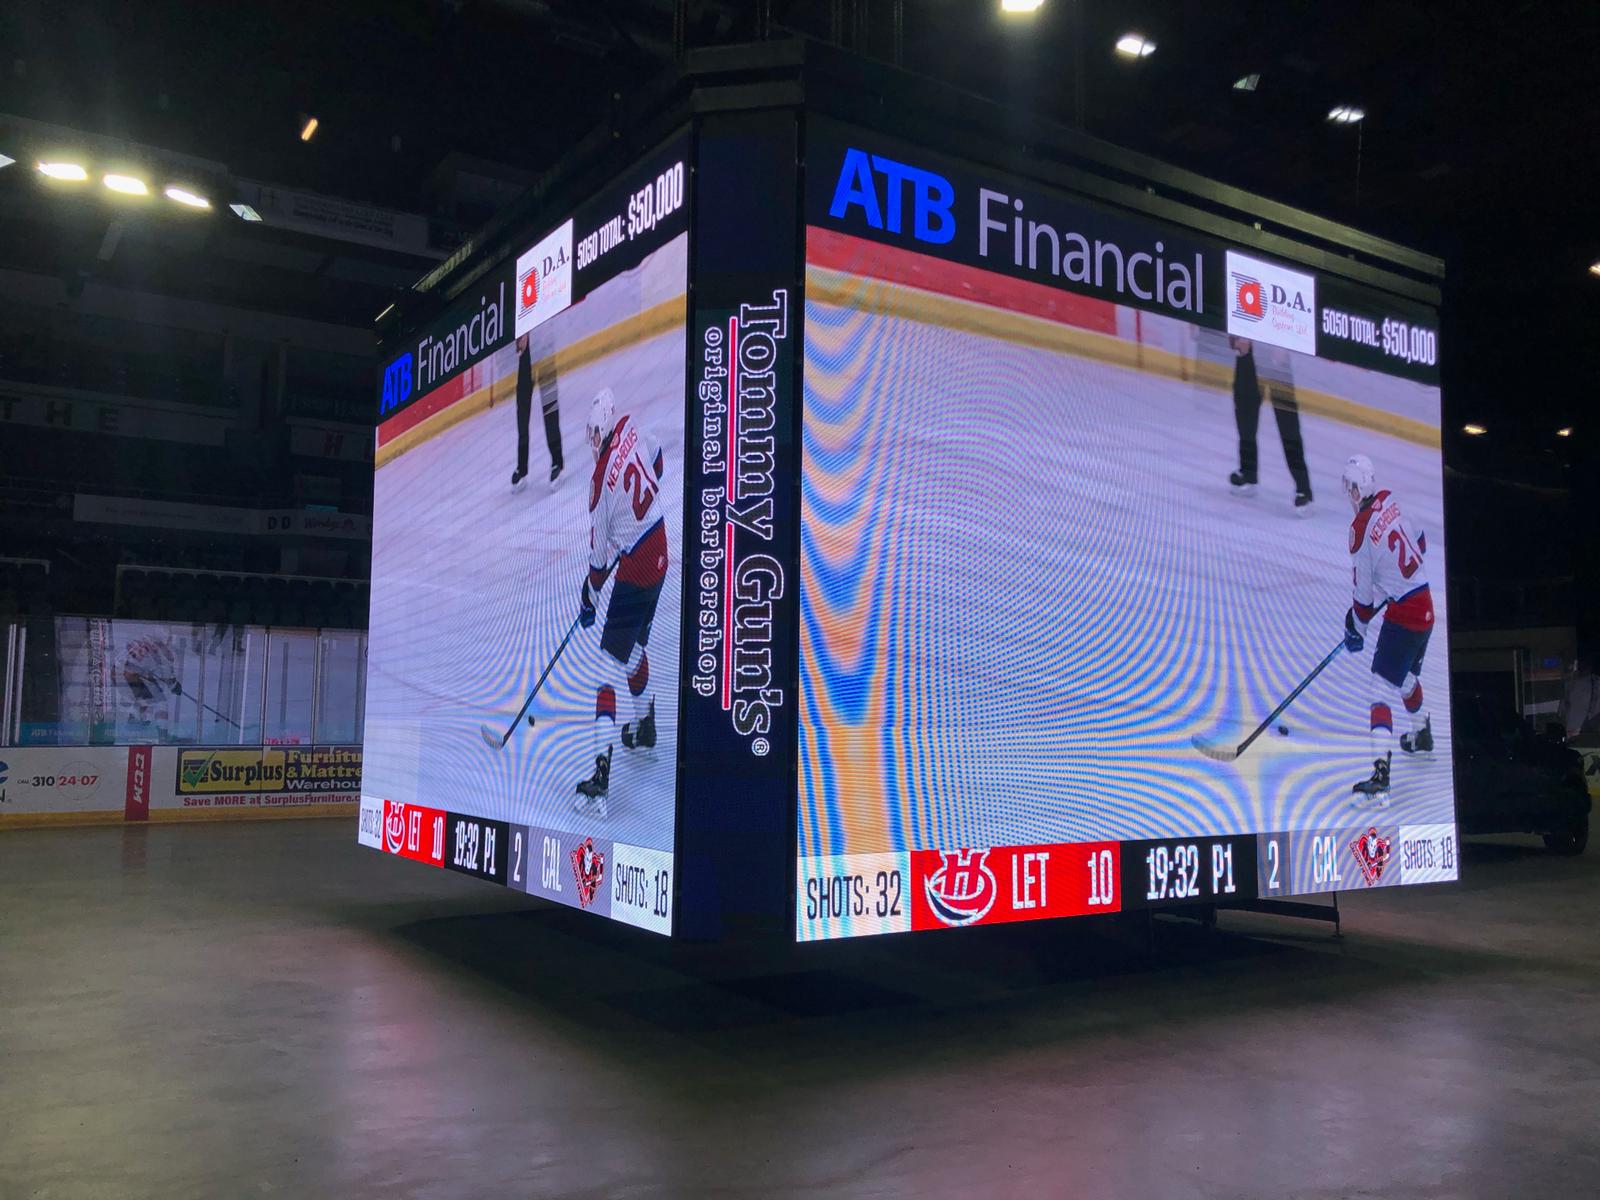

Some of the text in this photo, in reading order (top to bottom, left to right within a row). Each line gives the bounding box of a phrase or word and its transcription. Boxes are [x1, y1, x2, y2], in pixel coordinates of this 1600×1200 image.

[577, 161, 684, 270] 5050 TOTAL: $50,000
[828, 147, 1203, 313] ATB Financial
[542, 245, 570, 279] D.A.
[1270, 283, 1312, 313] D.A.
[380, 281, 505, 415] ATB Financial
[1322, 308, 1436, 366] 5050 TOTAL: $50,000
[726, 289, 787, 541] Tommy
[692, 326, 727, 697] original barbershop
[32, 775, 55, 787] 310
[133, 752, 146, 804] CCM
[209, 758, 283, 785] Surplus
[286, 768, 299, 778] &
[183, 796, 211, 807] Save
[214, 796, 246, 806] MORE
[249, 795, 262, 805] at
[408, 810, 422, 852] LET
[432, 816, 444, 861] 10
[454, 820, 497, 876] 19:32 P1
[1403, 838, 1437, 870] SHOTS:
[1440, 835, 1454, 870] 18
[513, 832, 522, 882] 2
[541, 836, 562, 892] CAL
[1012, 852, 1050, 910] LET
[1087, 849, 1114, 905] 10
[1146, 843, 1236, 900] 19:32 P1
[1267, 840, 1280, 889] 2
[1312, 836, 1342, 884] CAL
[615, 863, 649, 909] SHOTS:
[653, 869, 669, 918] 18
[806, 870, 901, 920] SHOTS: 32
